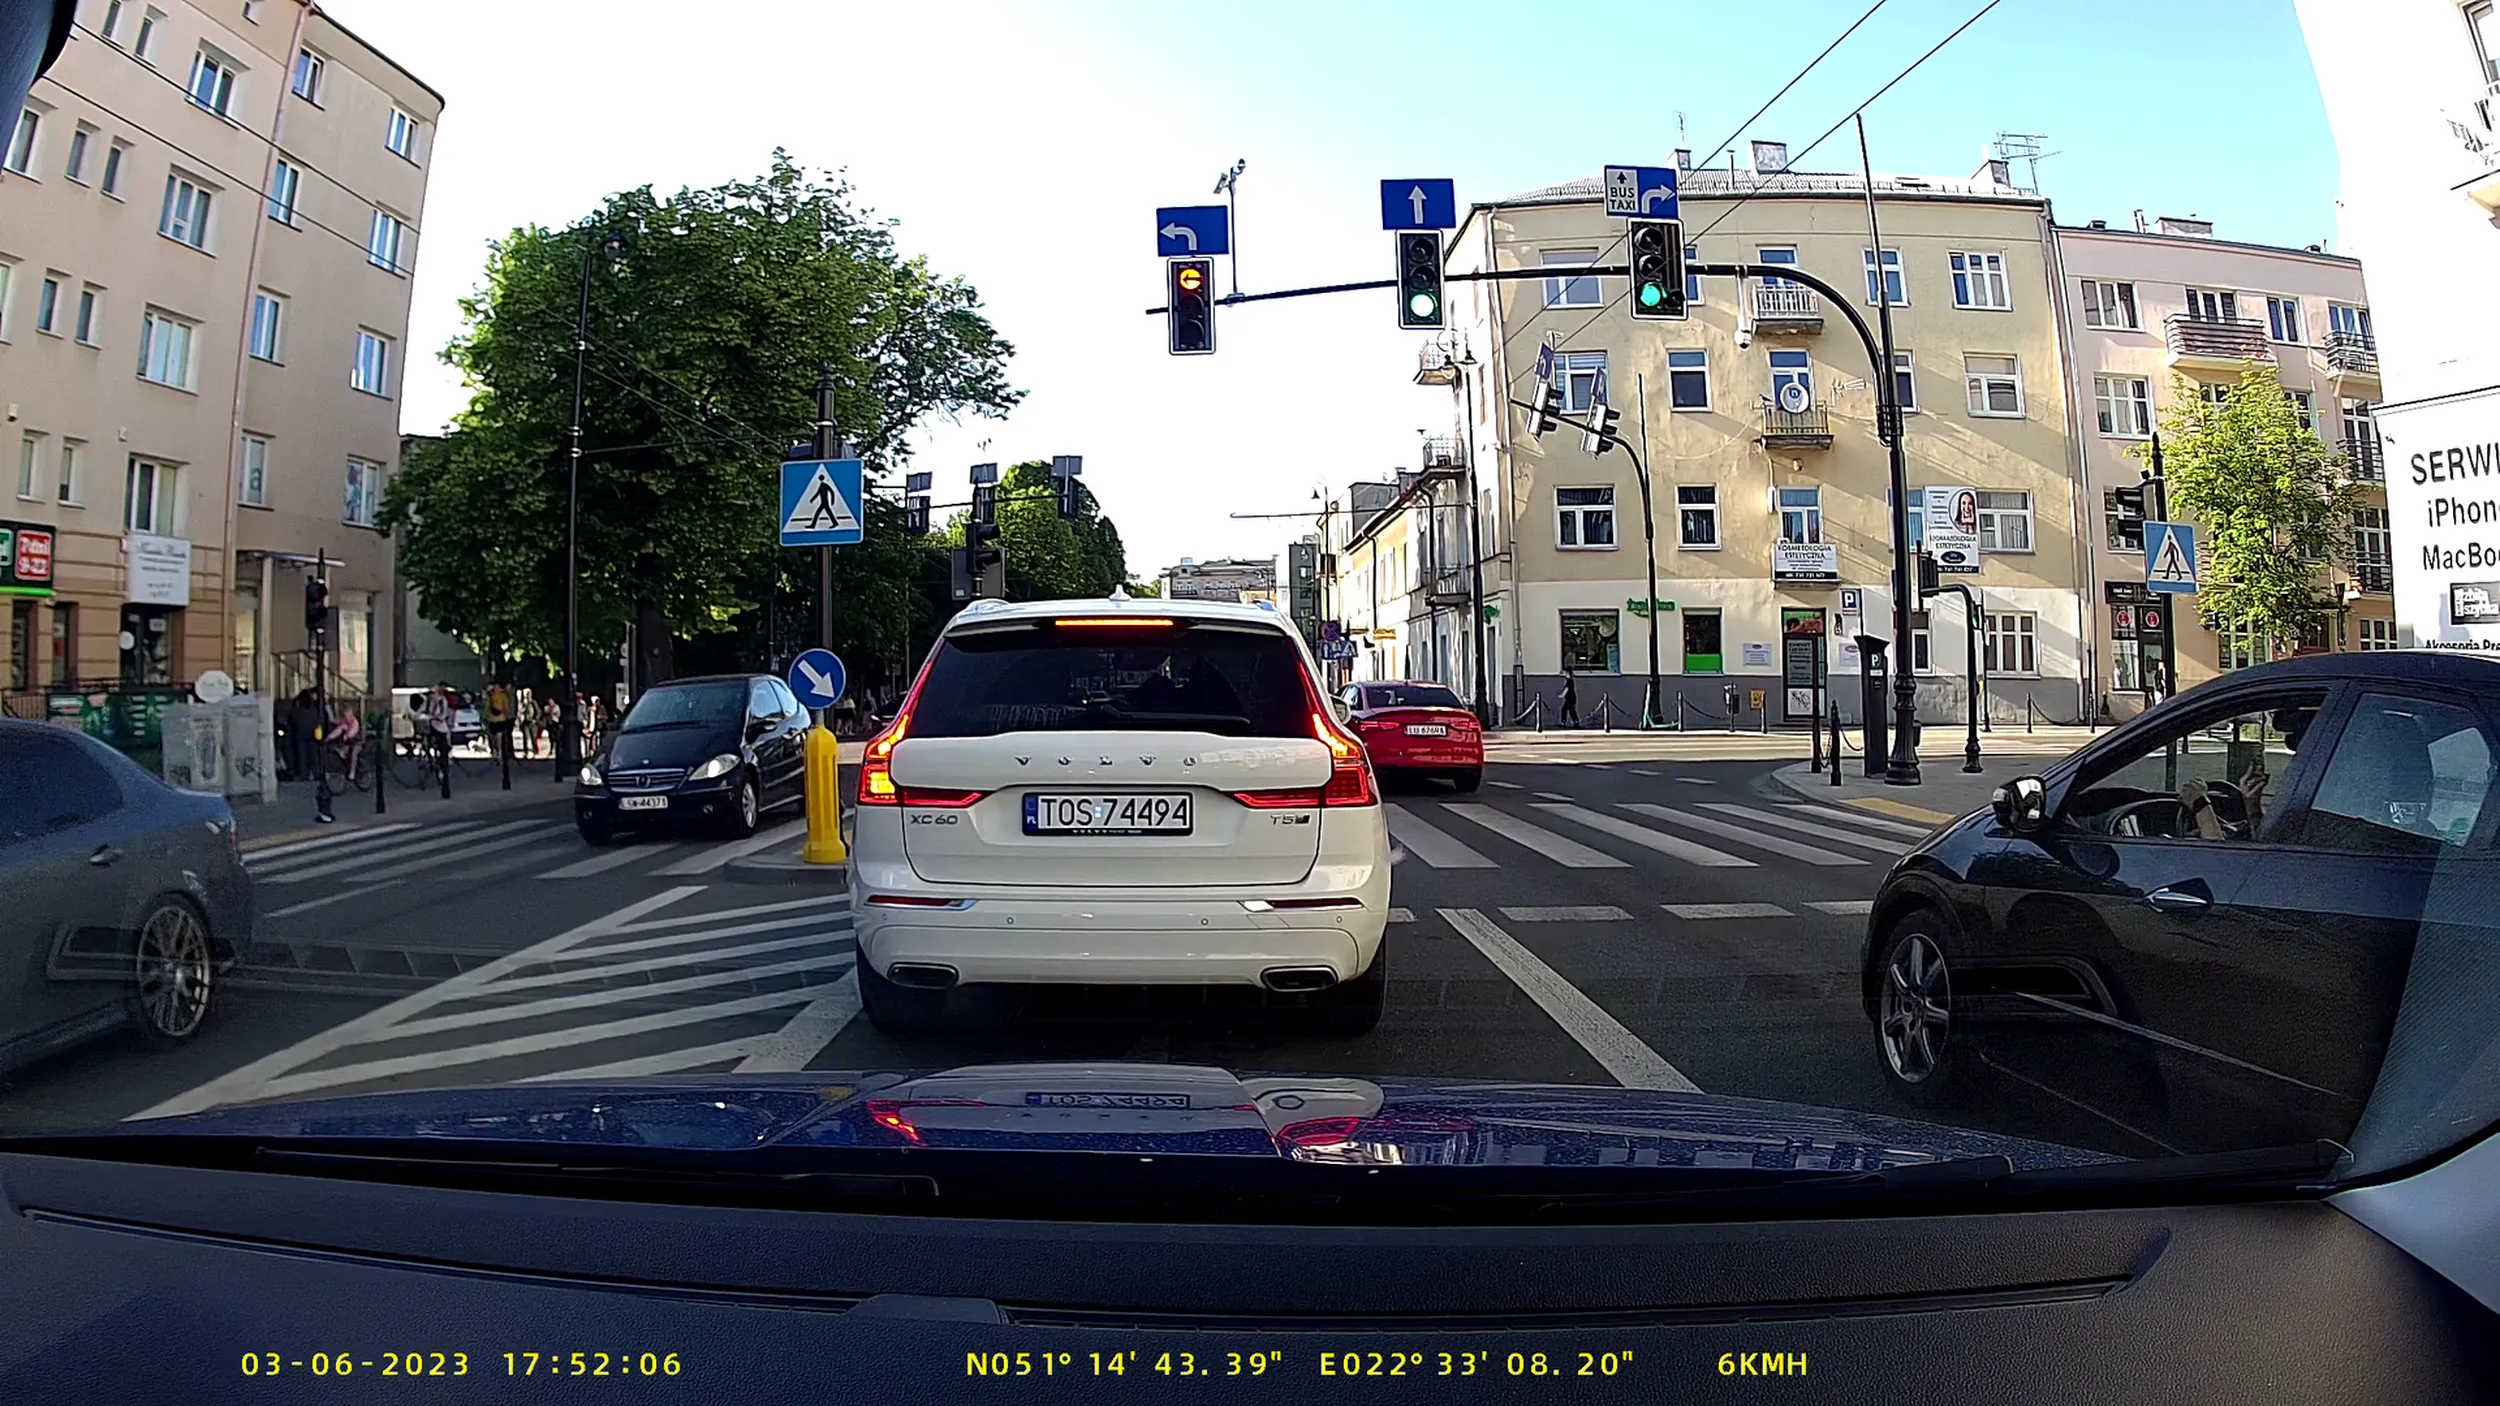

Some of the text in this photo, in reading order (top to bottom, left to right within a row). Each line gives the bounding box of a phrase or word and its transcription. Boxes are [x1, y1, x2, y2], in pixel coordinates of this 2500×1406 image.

[1610, 187, 1635, 198] BUS
[1609, 200, 1636, 210] TAXI
[2427, 497, 2500, 528] iPhon
[2423, 542, 2500, 570] MacBo
[1844, 592, 1855, 608] P
[1015, 755, 1197, 767] VOLVO
[1041, 798, 1188, 827] TOS 74494
[1026, 815, 1037, 825] PL
[1270, 814, 1294, 825] T5
